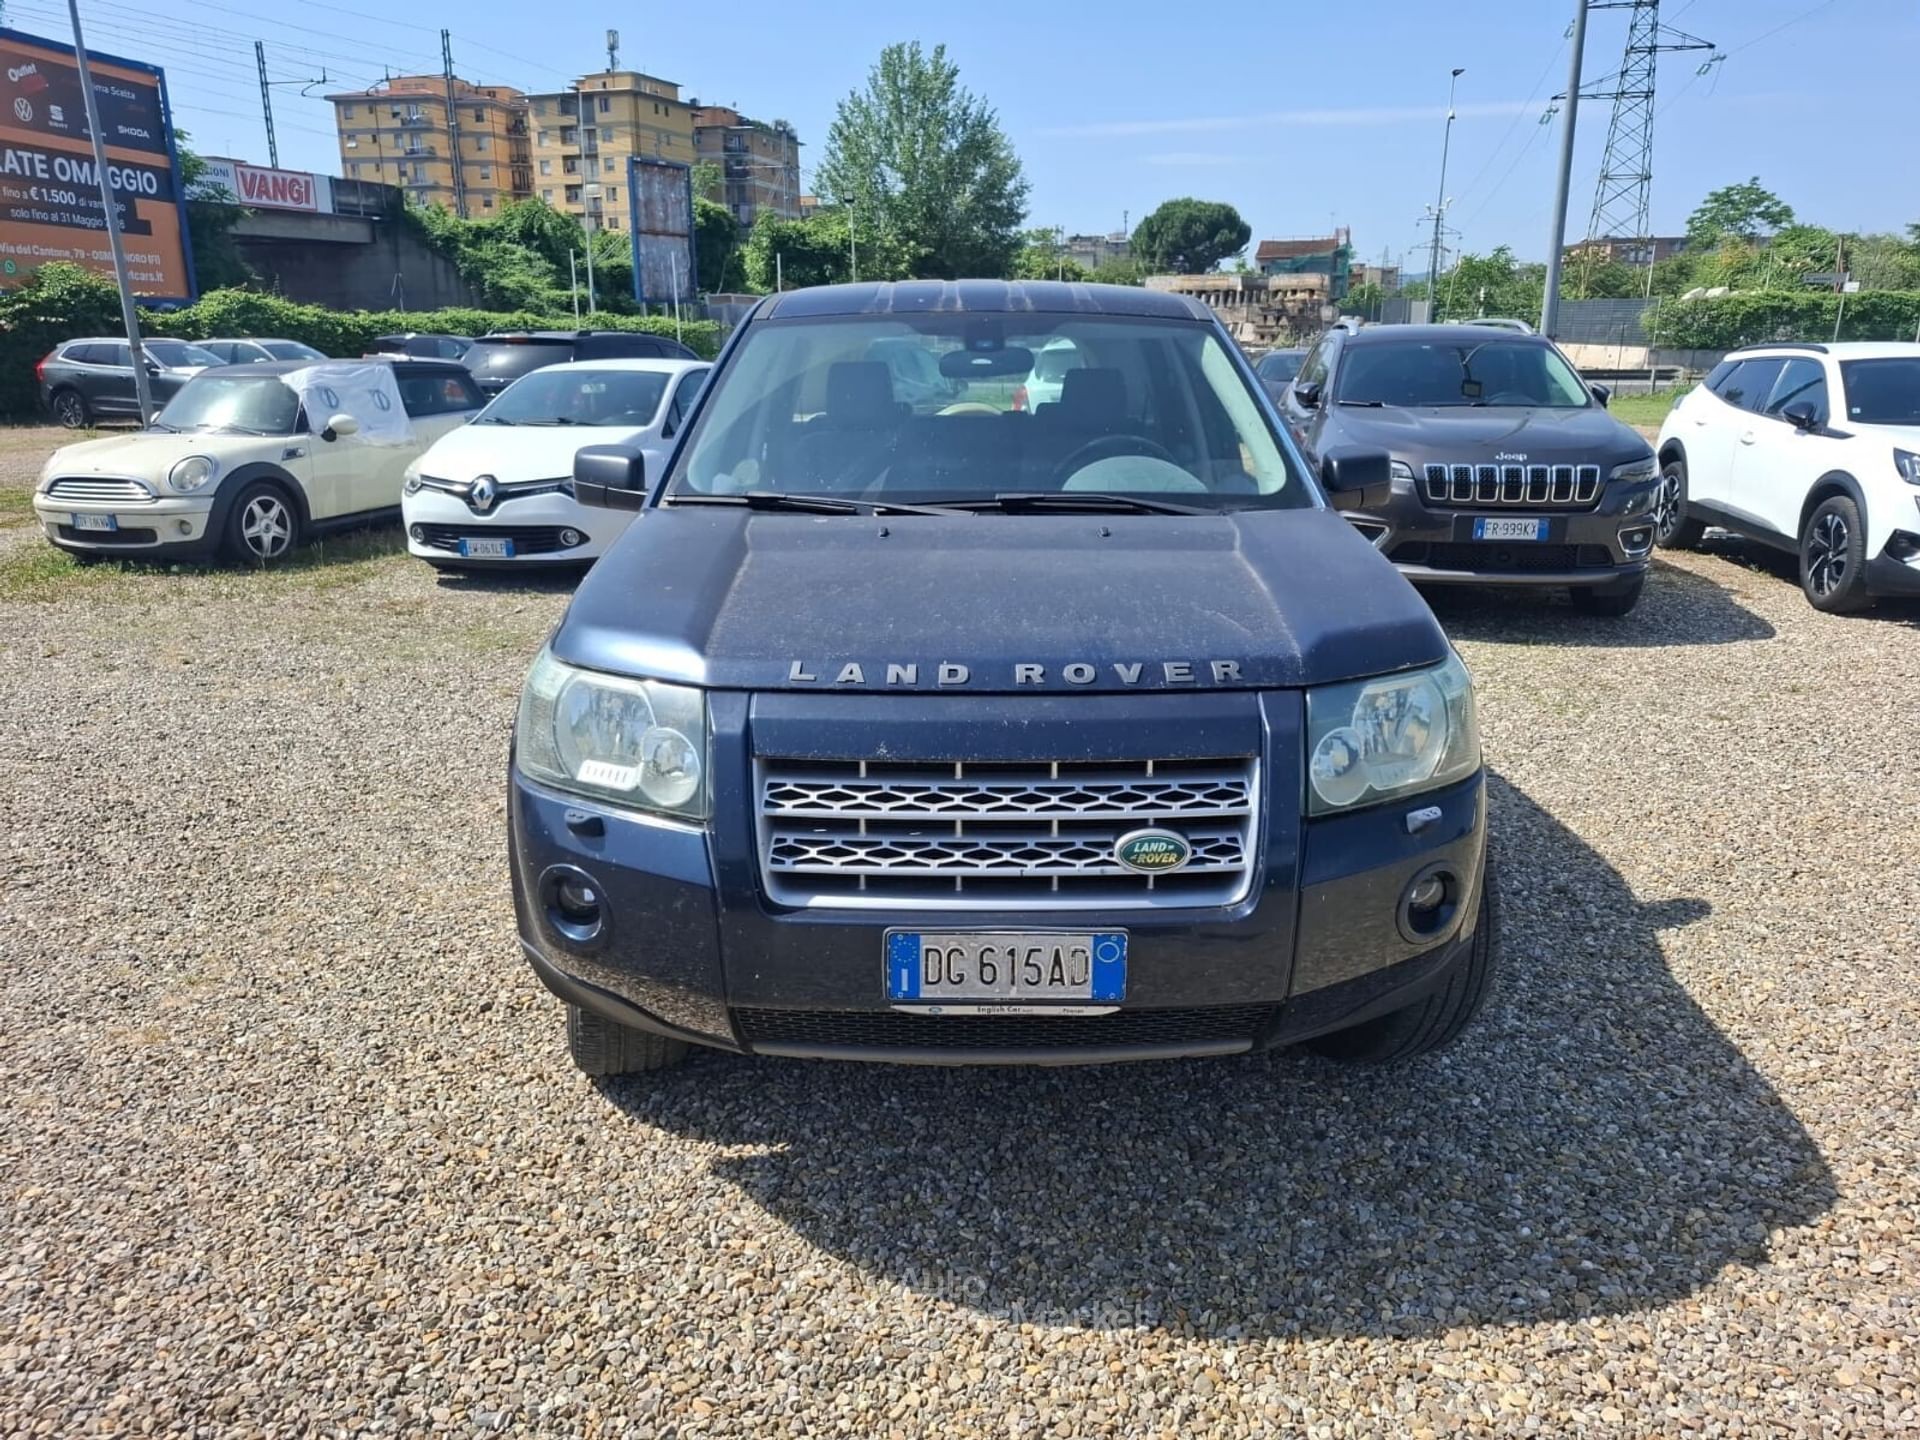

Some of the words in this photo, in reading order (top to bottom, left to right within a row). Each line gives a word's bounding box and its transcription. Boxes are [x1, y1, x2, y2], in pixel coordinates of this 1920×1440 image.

[8, 63, 38, 82] Outlet
[239, 170, 311, 205] VANGI
[41, 188, 76, 206] 1.500
[78, 197, 87, 207] di
[10, 207, 31, 219] solo
[31, 208, 49, 221] fino
[50, 211, 59, 223] al
[61, 211, 70, 223] 31
[72, 213, 103, 228] Maggio
[1495, 451, 1528, 462] Jeep
[788, 659, 971, 686] LAND
[1015, 659, 1245, 685] ROVER
[1134, 842, 1168, 853] LAND
[1137, 853, 1178, 863] ROVER
[924, 947, 966, 986] DG
[979, 947, 1089, 986] 615AD
[977, 1006, 1005, 1015] English
